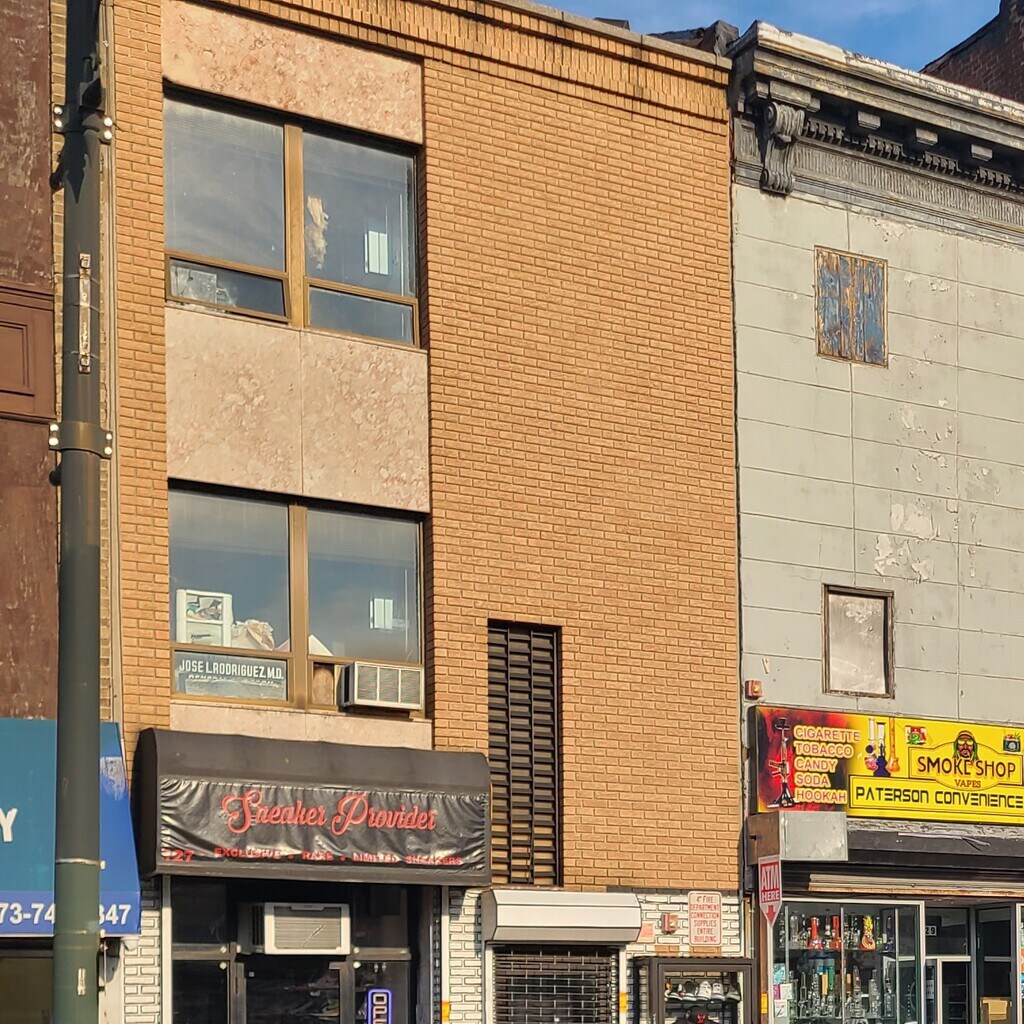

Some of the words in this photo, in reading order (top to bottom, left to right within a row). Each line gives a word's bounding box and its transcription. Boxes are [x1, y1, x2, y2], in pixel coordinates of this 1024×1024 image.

[179, 659, 204, 673] JOSE
[794, 726, 860, 742] CIGARETTE
[794, 743, 854, 757] TOBACCO
[795, 758, 838, 772] CANDY
[917, 756, 970, 775] SMOKE
[975, 760, 1016, 779] SHOP
[795, 774, 830, 787] SODA
[954, 778, 981, 789] VAPES
[796, 789, 847, 803] HOOKAH
[855, 786, 929, 804] PATERSON
[935, 790, 1023, 809] CONVENIENCE
[221, 789, 327, 834] Sneaker
[330, 790, 437, 835] Provider
[163, 848, 194, 863] 127
[213, 847, 282, 859] EXCLUSIVE
[301, 850, 334, 861] RARE
[405, 854, 463, 866] SNEAKERS
[761, 864, 780, 891] ATM
[702, 895, 715, 903] FIRE
[761, 891, 780, 901] HERE
[690, 911, 720, 919] CONNECTION
[694, 935, 717, 943] BUILDING
